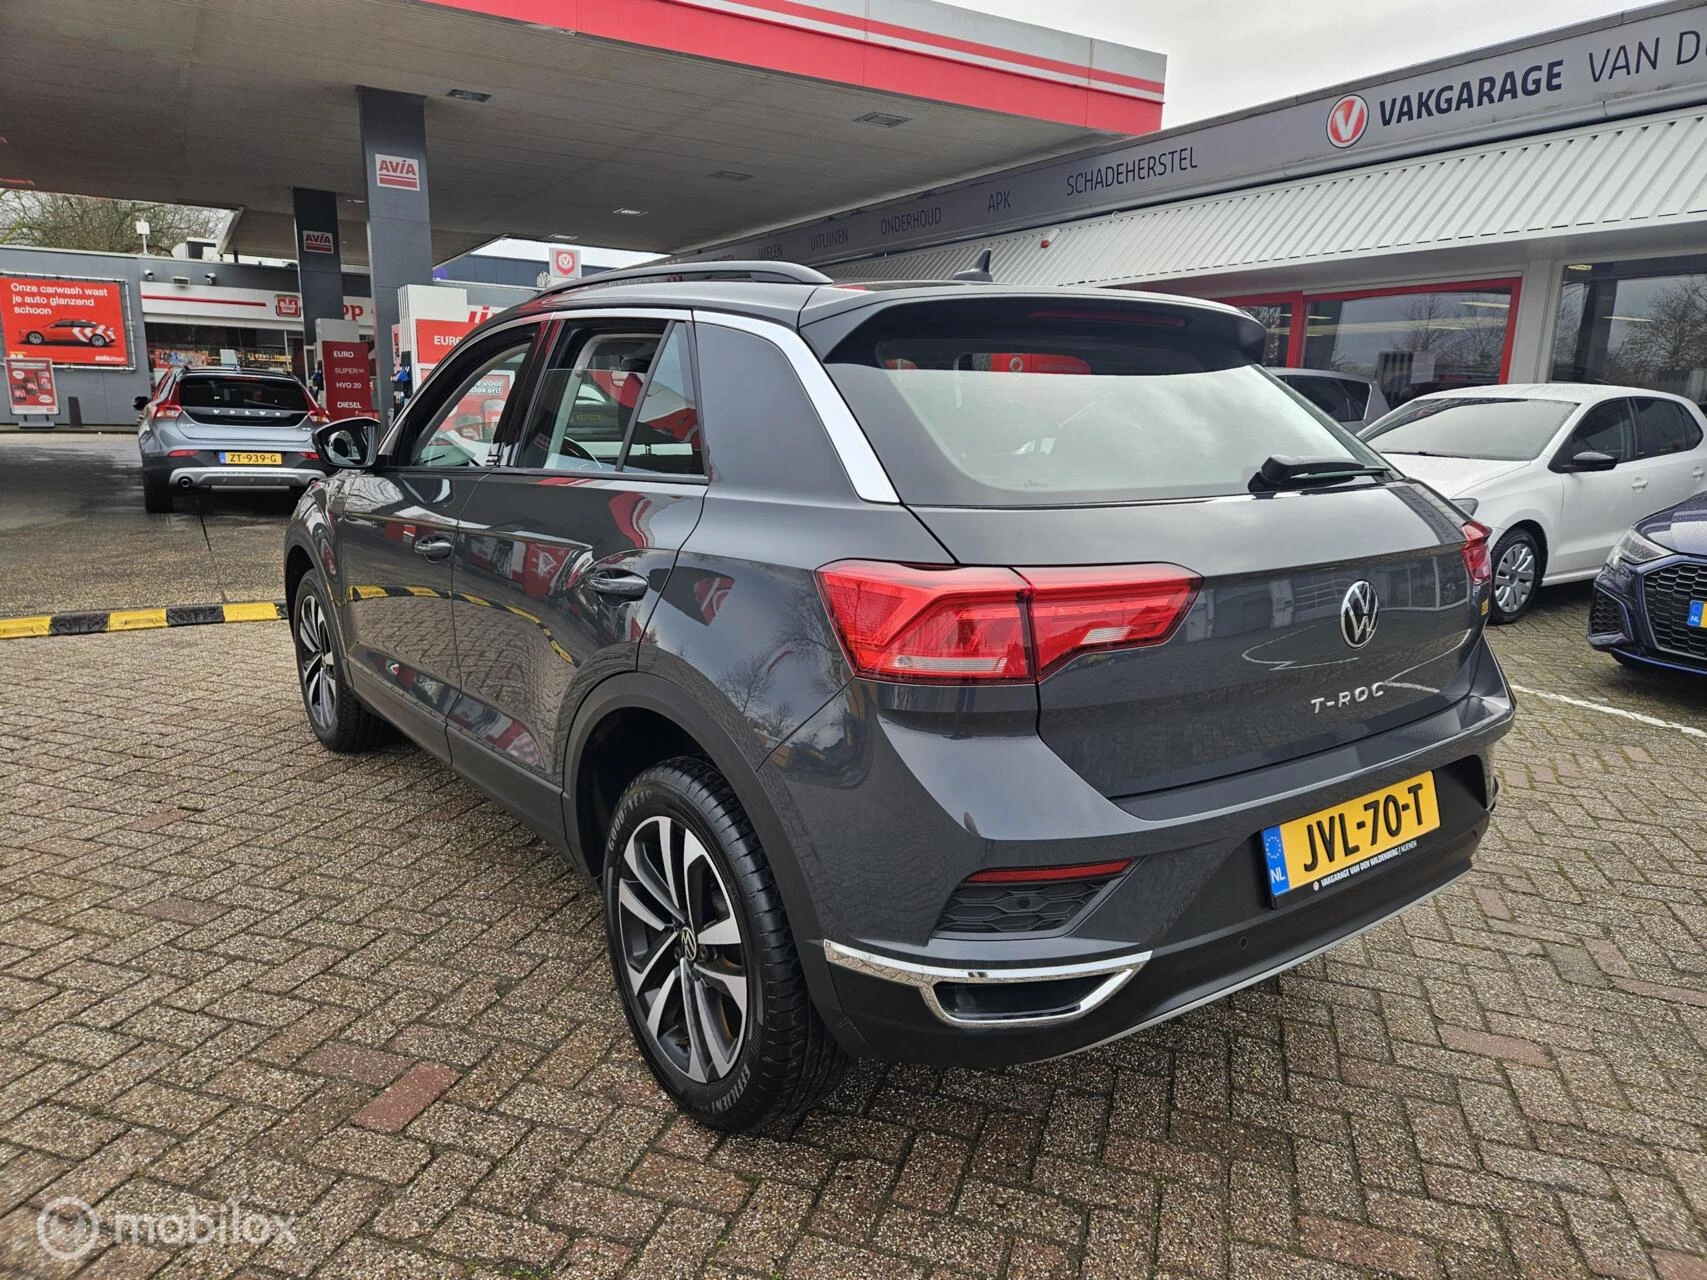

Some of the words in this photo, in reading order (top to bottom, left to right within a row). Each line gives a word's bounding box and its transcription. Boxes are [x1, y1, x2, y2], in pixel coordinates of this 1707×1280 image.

[1379, 59, 1564, 127] VAKGARAGE
[1588, 37, 1660, 83] VAN
[1676, 29, 1707, 66] D
[379, 160, 417, 176] AVIA
[1066, 146, 1198, 196] SCHADEHERSTEL
[987, 191, 1011, 213] APK
[880, 207, 942, 236] ONDERHOUD
[305, 233, 331, 244] AVIA
[11, 283, 37, 293] Onze
[40, 286, 82, 296] carwash
[84, 287, 108, 296] wast
[12, 294, 22, 305] je
[24, 295, 47, 304] auto
[49, 297, 95, 306] glanzend
[14, 306, 52, 315] schoon
[333, 350, 354, 358] EURO
[230, 454, 277, 463] ZT-939-G
[1311, 681, 1385, 714] T-ROC
[1304, 783, 1423, 872] JVL-70-T
[1270, 866, 1286, 884] NL
